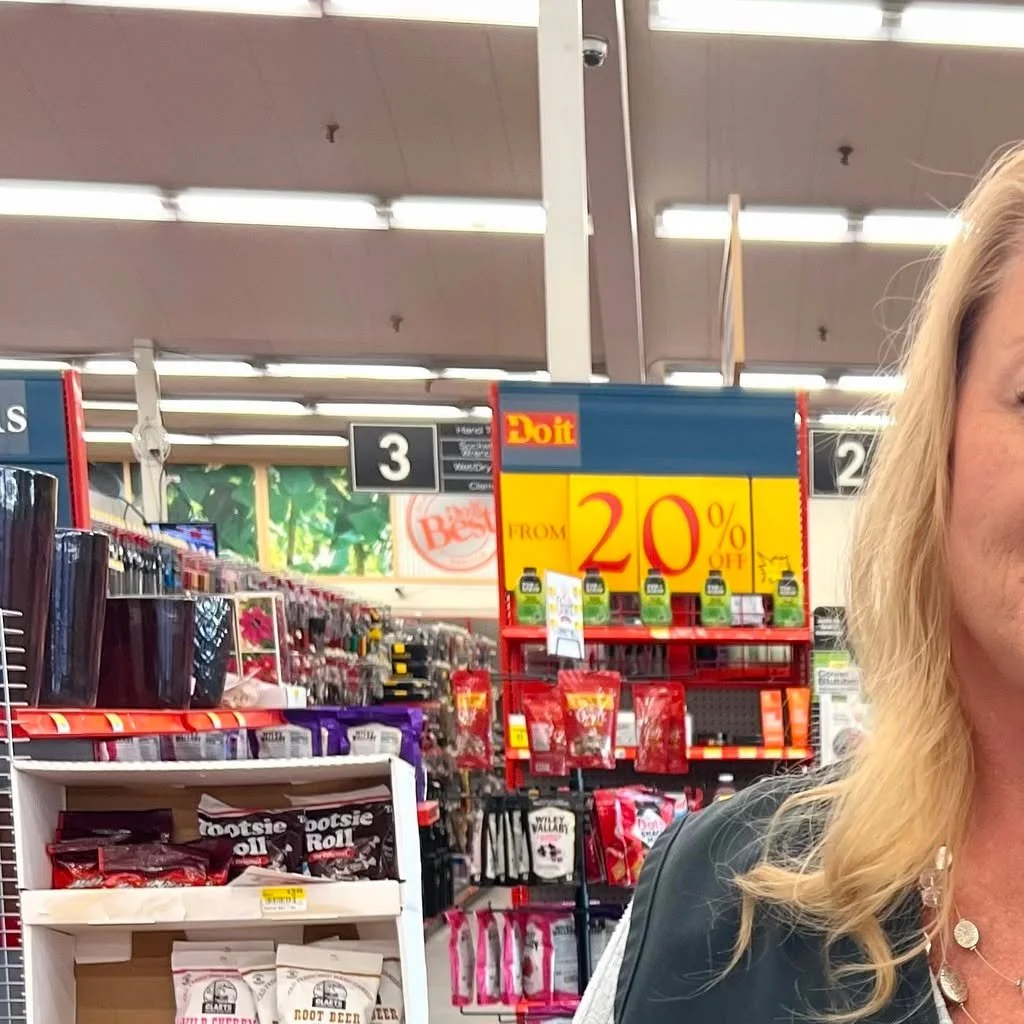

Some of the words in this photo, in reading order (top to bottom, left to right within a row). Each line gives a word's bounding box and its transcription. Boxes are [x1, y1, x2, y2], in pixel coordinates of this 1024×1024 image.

[379, 432, 411, 481] 3
[838, 442, 865, 486] 2
[507, 522, 566, 541] FROM
[709, 551, 747, 569] OFF
[305, 811, 373, 832] ootsie
[233, 837, 268, 855] oll
[306, 828, 354, 851] Roll
[294, 1009, 324, 1021] ROOT
[329, 1011, 361, 1024] BEER
